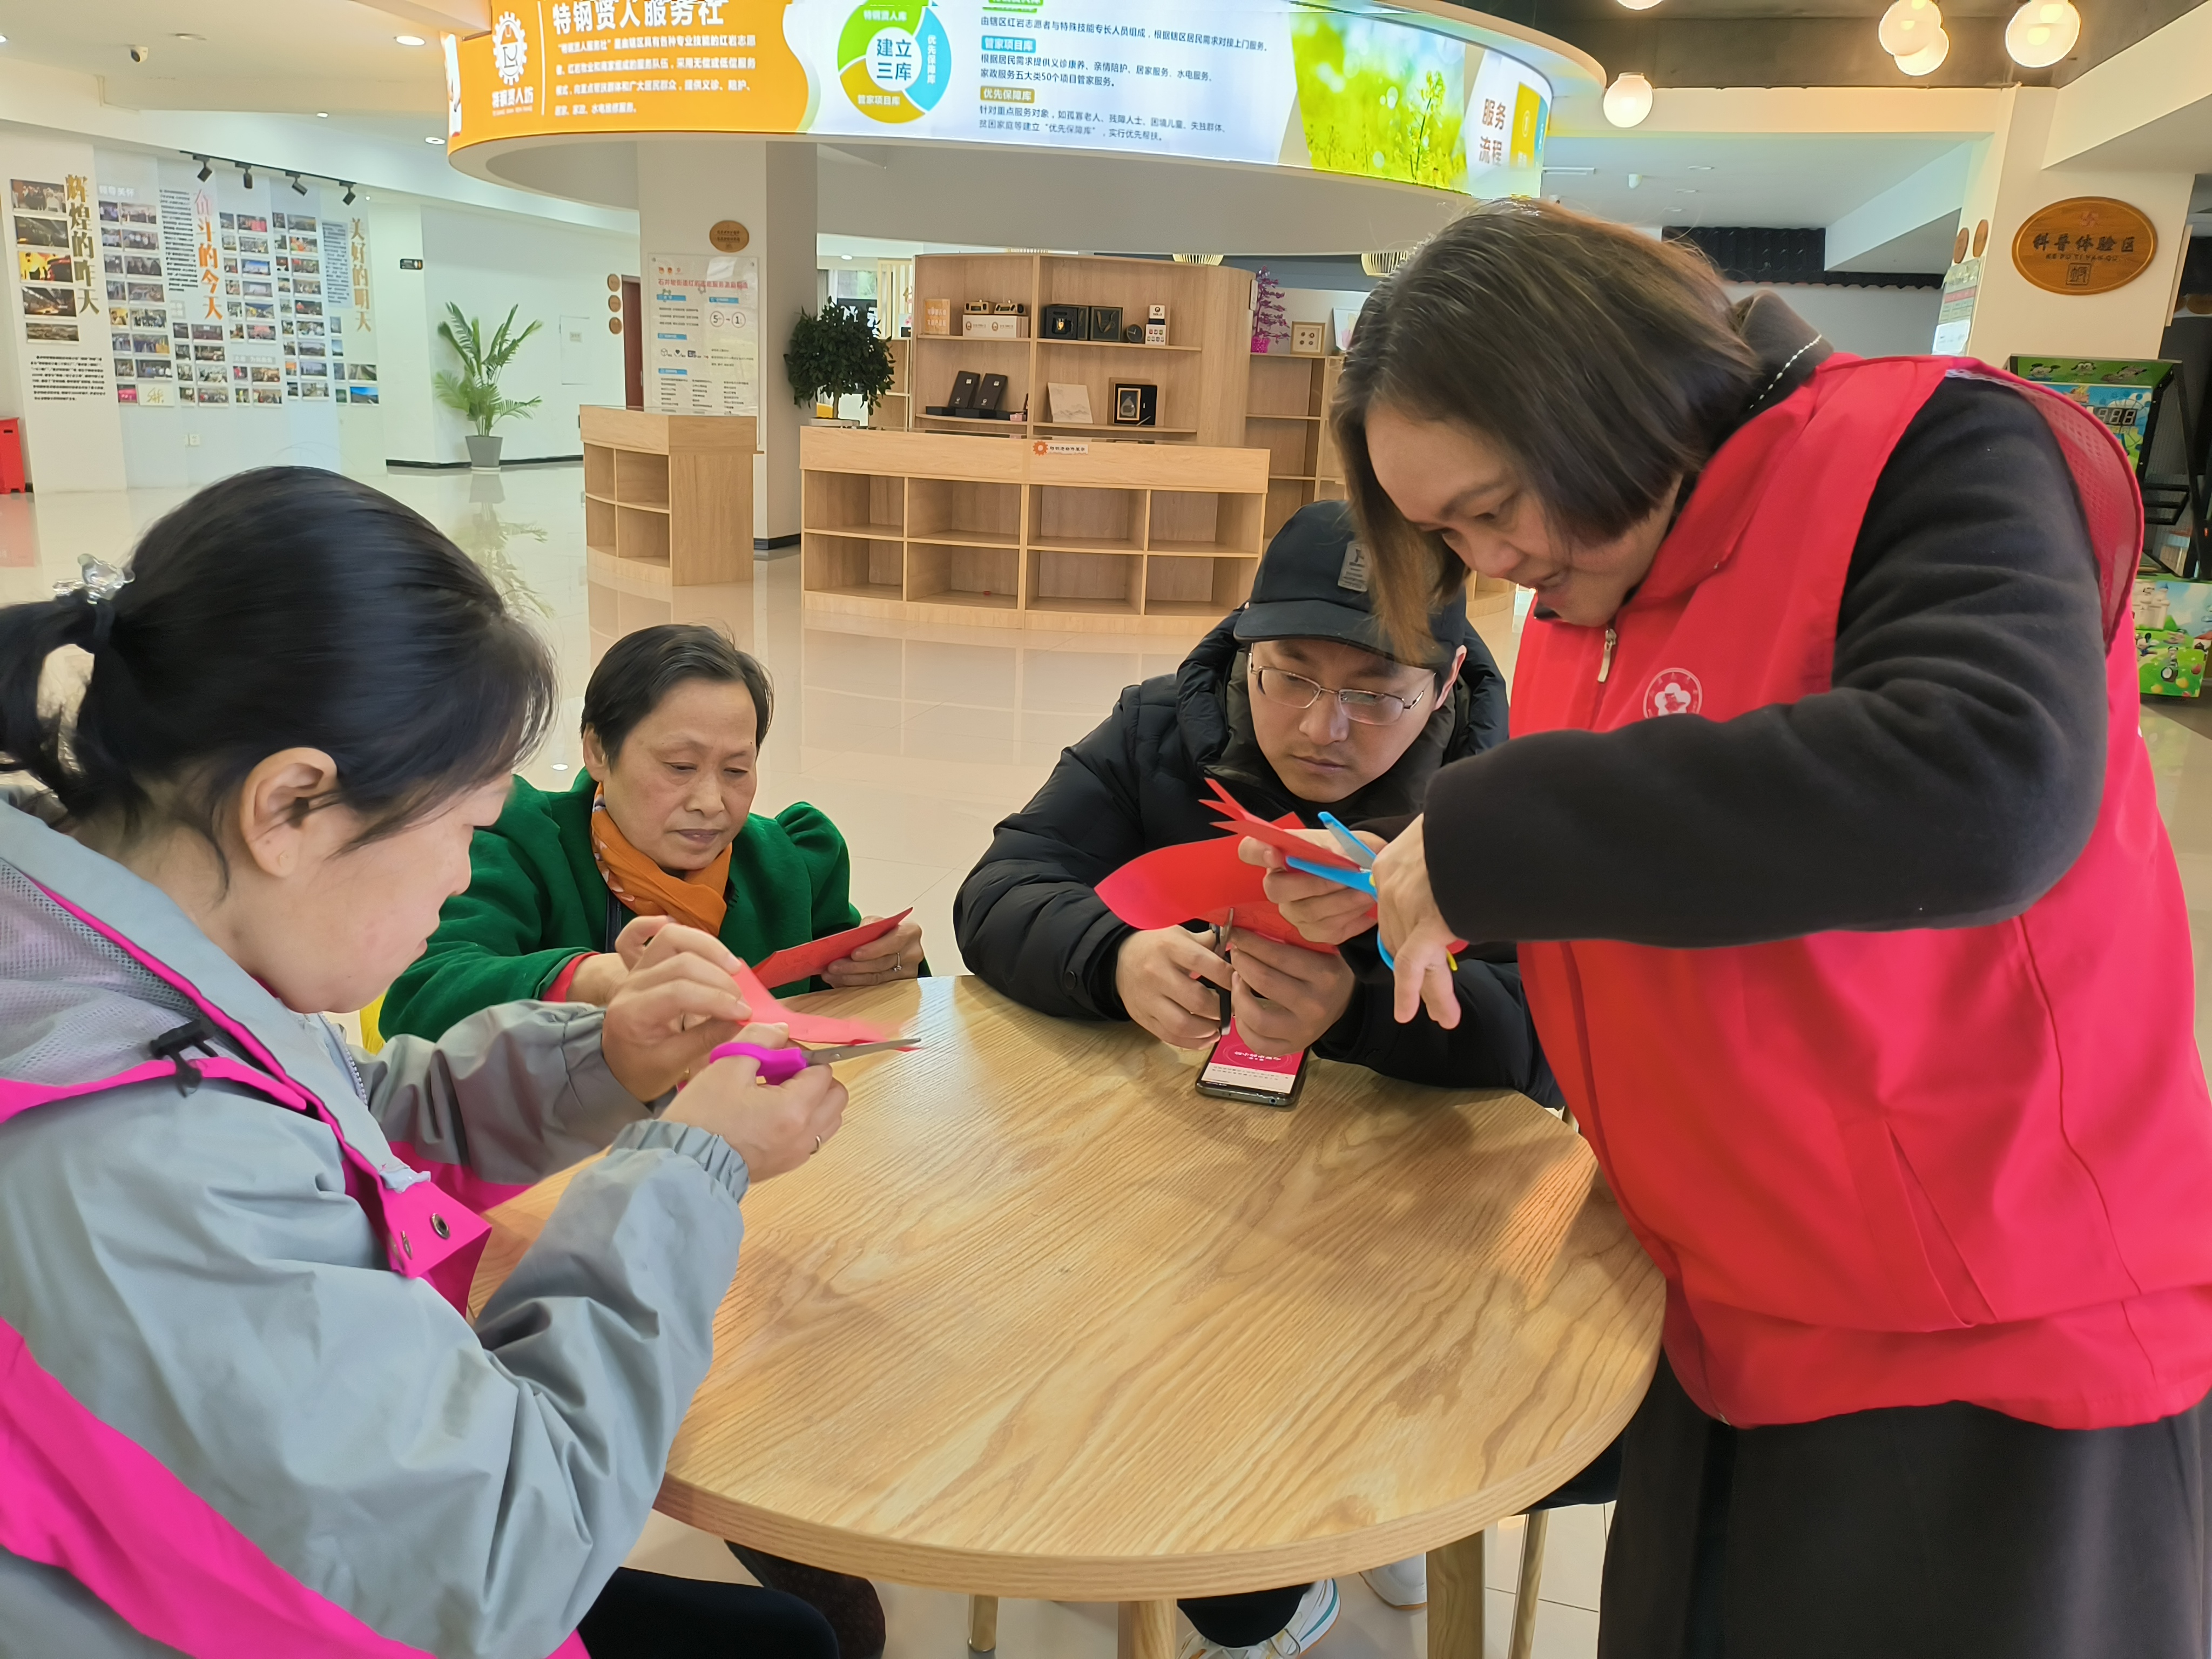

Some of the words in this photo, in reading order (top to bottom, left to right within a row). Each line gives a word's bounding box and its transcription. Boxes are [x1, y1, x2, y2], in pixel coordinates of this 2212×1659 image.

[552, 0, 724, 35] 特钢贤人服务社
[876, 38, 912, 57] 建立
[984, 37, 1034, 52] 管家项目库
[927, 35, 936, 84] 优先保障库
[876, 63, 912, 81] 三库
[858, 95, 900, 105] 管家项目库
[983, 88, 1032, 102] 优先保障库
[1482, 98, 1506, 130] 服务
[1479, 136, 1502, 167] 流程
[65, 174, 100, 314] 辉煌的昨天
[2033, 233, 2135, 252] 科普体验区
